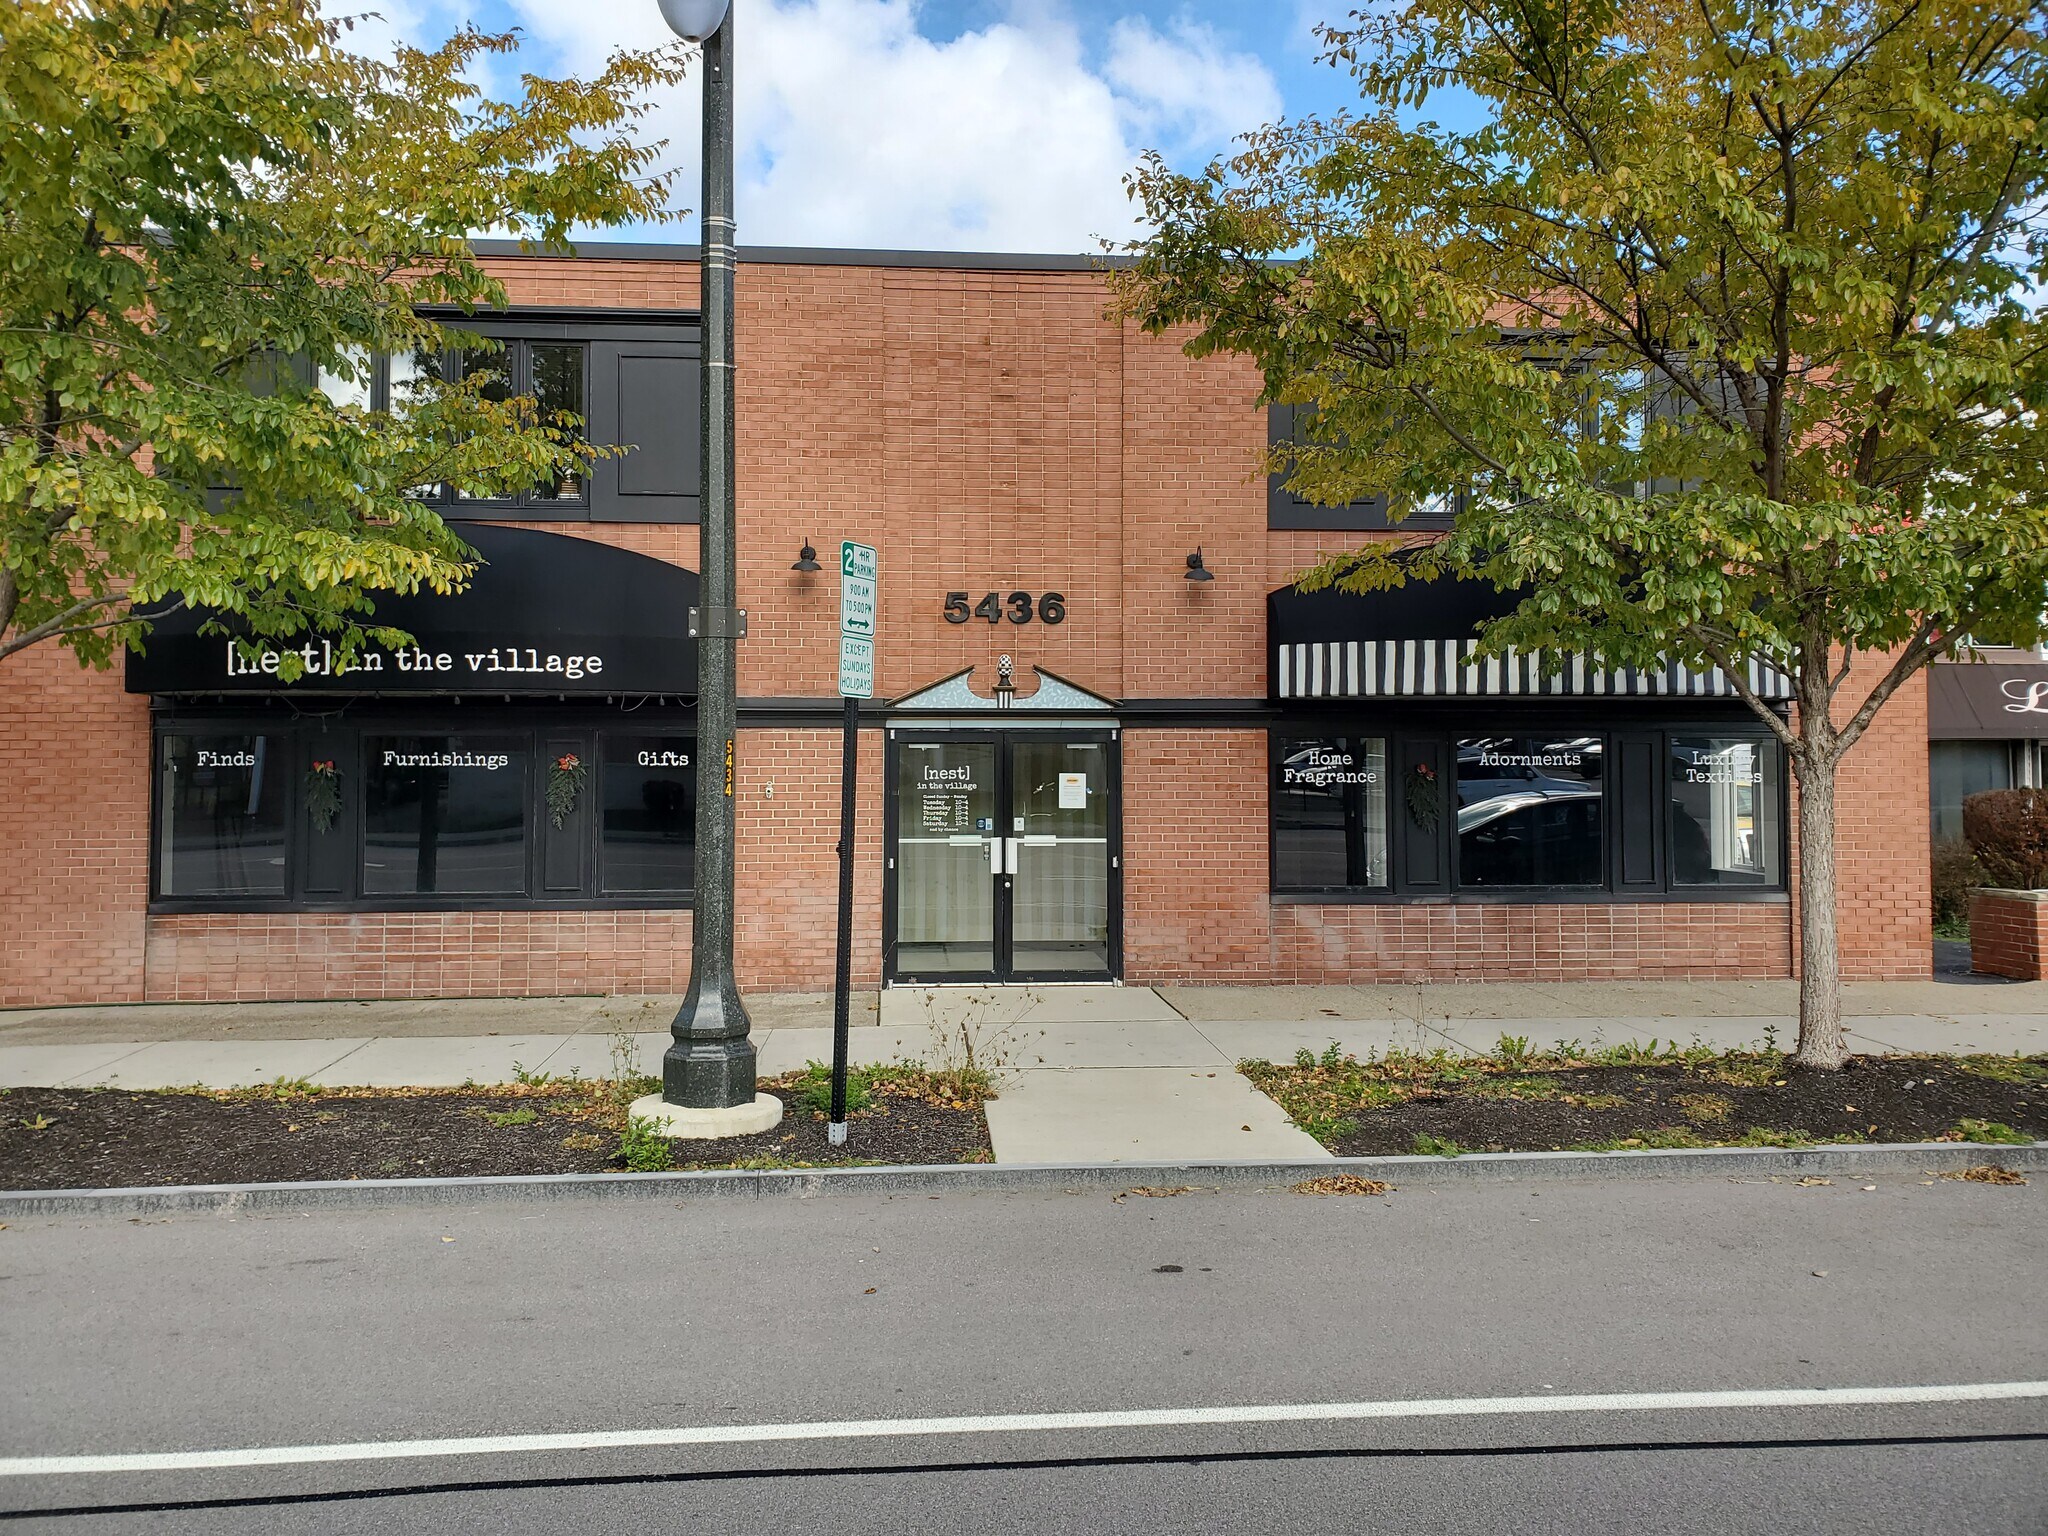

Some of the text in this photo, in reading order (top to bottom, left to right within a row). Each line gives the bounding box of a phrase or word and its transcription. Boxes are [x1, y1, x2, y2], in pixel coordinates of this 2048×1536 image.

[845, 548, 870, 572] 2 HR
[854, 562, 875, 578] PARKING
[943, 591, 1066, 624] 5436
[845, 643, 869, 657] EXCEPT
[227, 639, 603, 680] [net] in the village
[843, 659, 870, 674] SUNDAYS
[842, 676, 871, 690] HOLIDAYS
[197, 751, 255, 767] Finds
[383, 751, 508, 770] Furnishings
[638, 751, 689, 766] Gifts
[1308, 751, 1352, 765] Home
[1479, 751, 1581, 766] Adornments
[1692, 751, 1756, 769] Luxuy
[725, 740, 733, 797] 5434
[924, 765, 970, 780] [nest]
[1686, 768, 1762, 783] Texties
[1283, 768, 1377, 786] Fragrance
[917, 782, 977, 790] in the village
